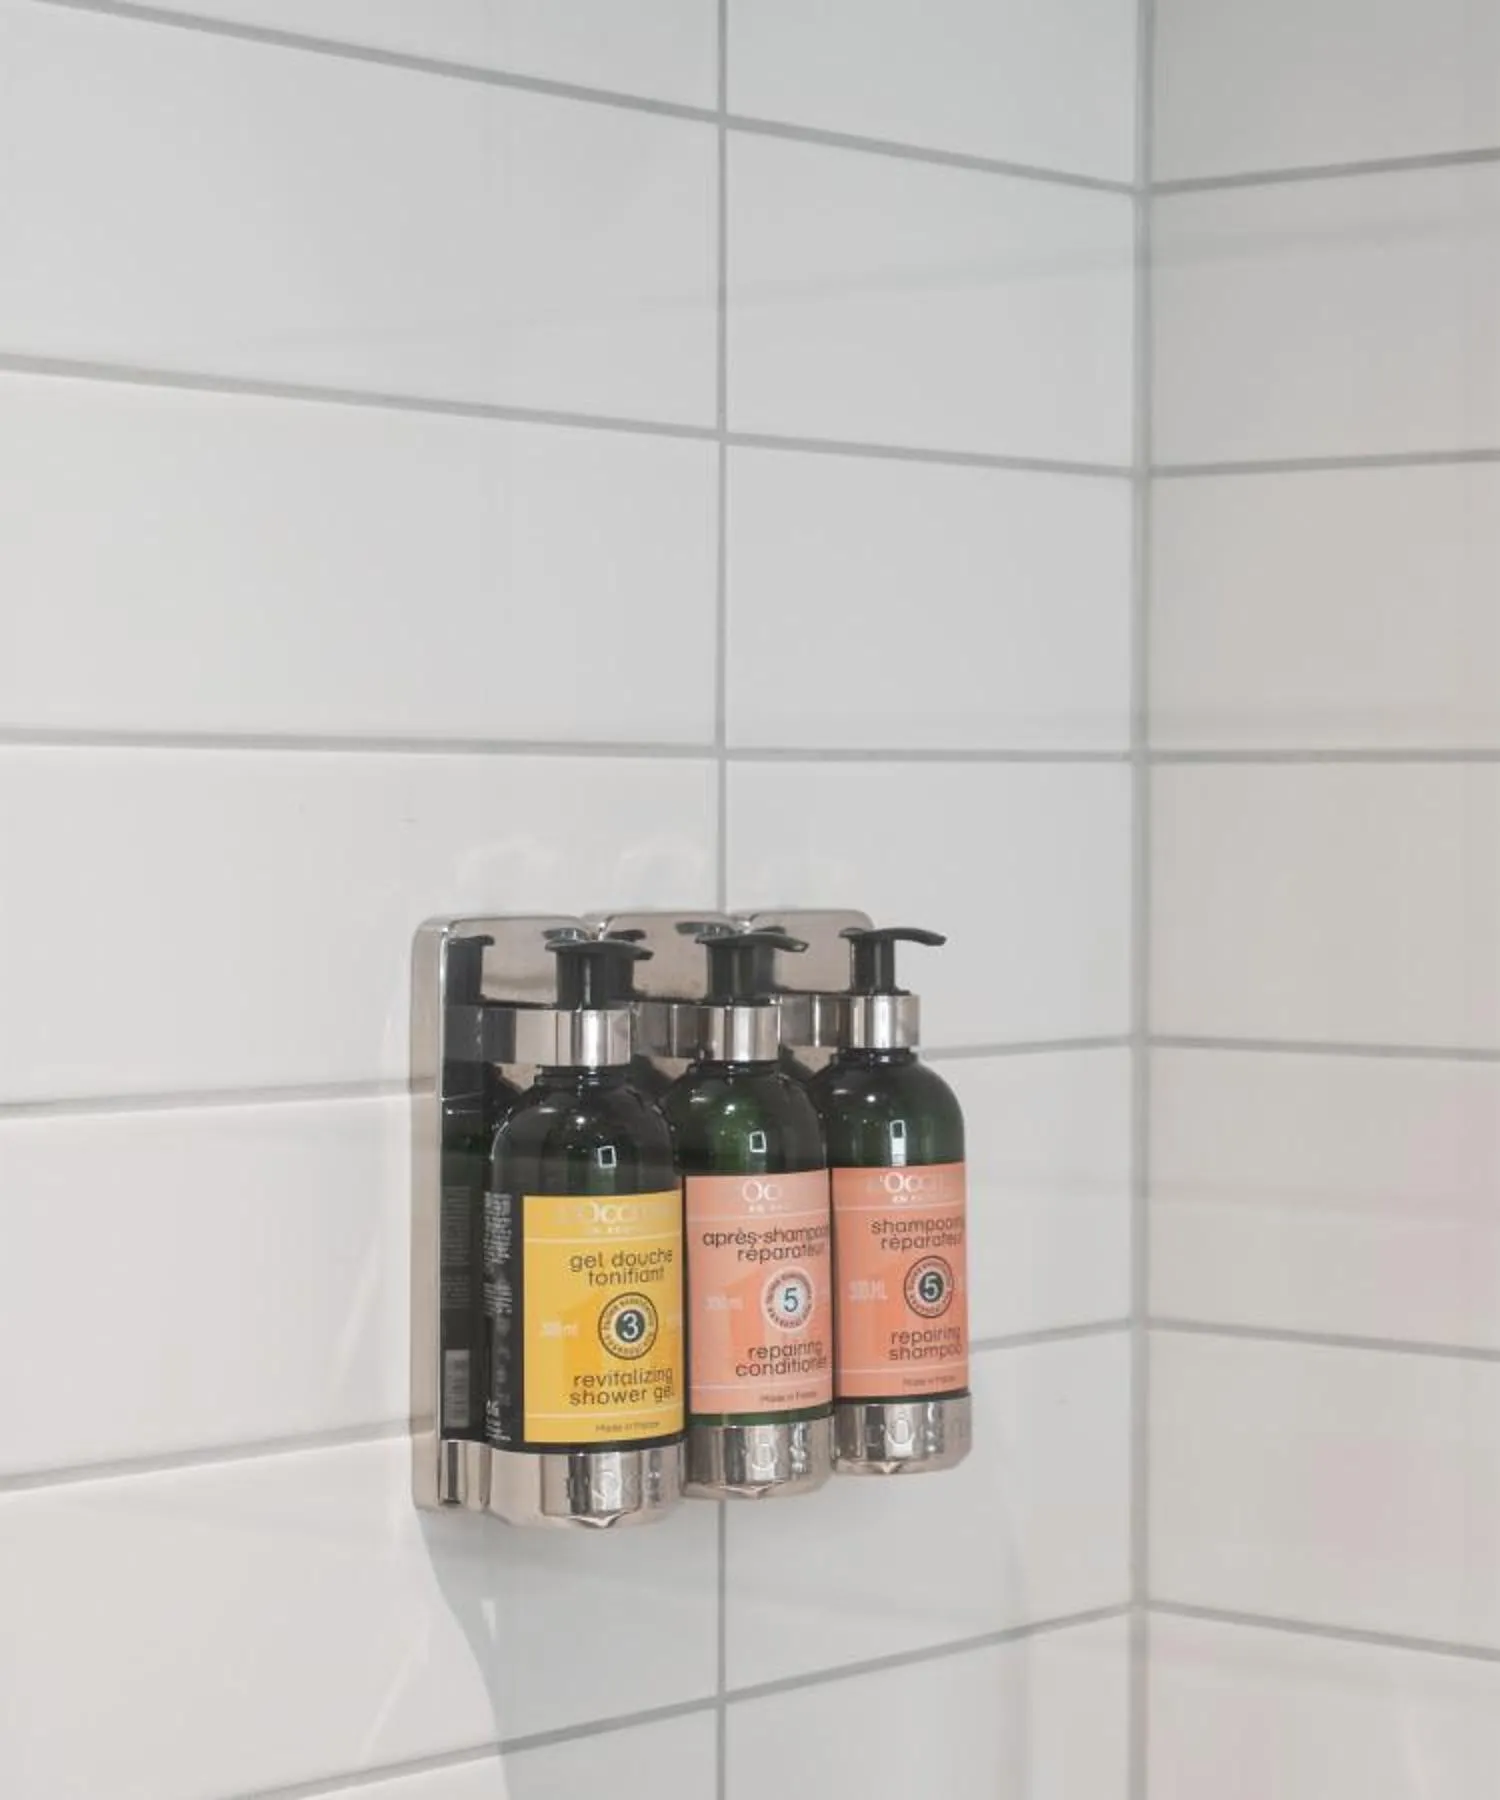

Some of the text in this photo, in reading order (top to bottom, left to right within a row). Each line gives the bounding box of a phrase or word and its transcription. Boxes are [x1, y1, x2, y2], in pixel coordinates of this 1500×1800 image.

[702, 1225, 829, 1248] après-shampoo
[869, 1216, 963, 1236] shampoo
[569, 1248, 673, 1273] gel douche
[588, 1266, 665, 1287] tonifiant
[924, 1275, 940, 1300] 5
[783, 1286, 800, 1313] 5
[621, 1313, 640, 1340] 3
[889, 1326, 961, 1347] repairing
[747, 1341, 823, 1360] repairing
[888, 1343, 963, 1361] shampoo
[572, 1367, 674, 1389] revitalizing
[735, 1356, 827, 1378] conditioner
[568, 1389, 647, 1406] shower
